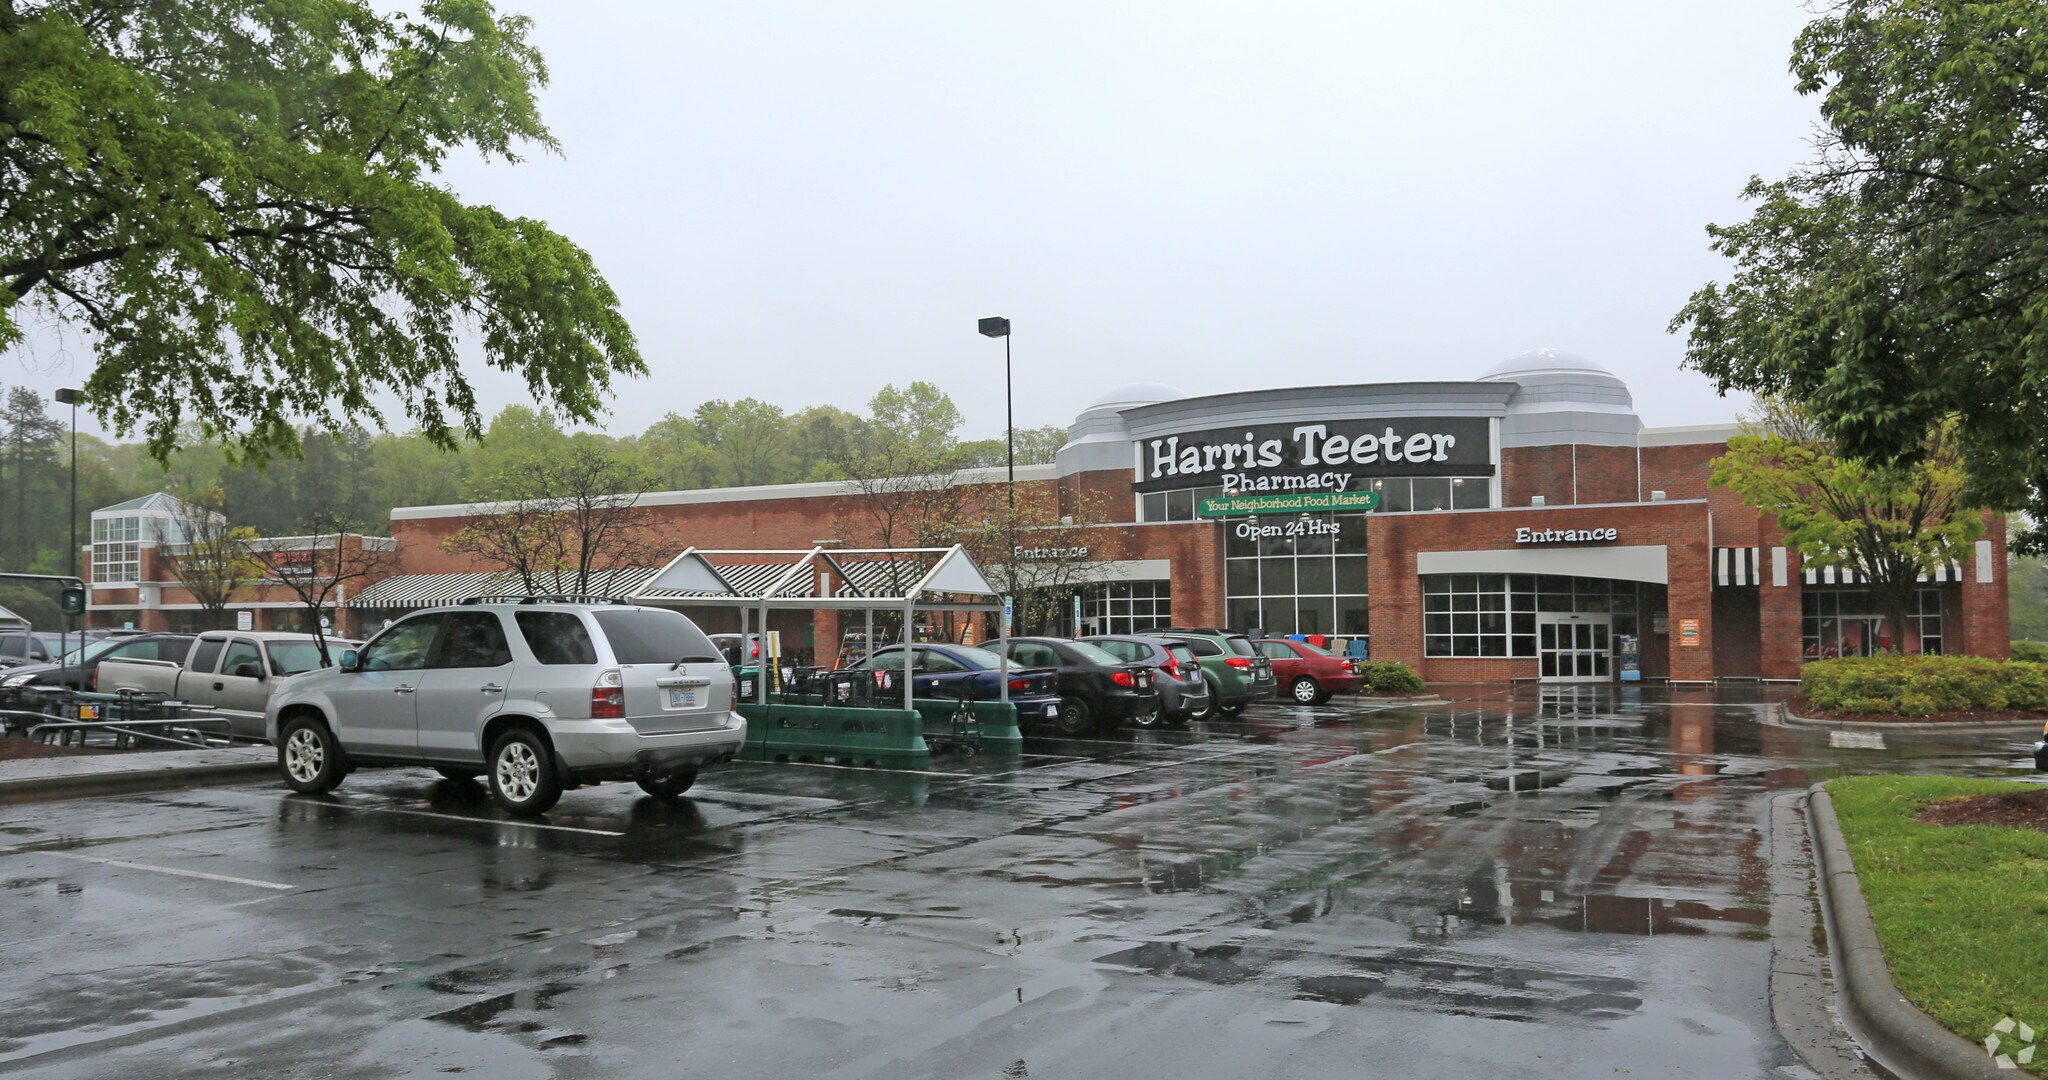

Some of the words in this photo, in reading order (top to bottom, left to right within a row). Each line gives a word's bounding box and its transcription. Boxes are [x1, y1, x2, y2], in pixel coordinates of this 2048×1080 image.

[1151, 432, 1282, 478] Harris
[1293, 424, 1455, 465] Teeter
[1222, 472, 1351, 493] Pharmacy
[1206, 499, 1230, 512] Your
[1231, 496, 1302, 513] Neighborhood
[1304, 495, 1329, 507] Food
[1331, 494, 1371, 506] Market
[1236, 522, 1282, 541] Open
[1286, 521, 1305, 536] 24
[1308, 519, 1340, 535] Hrs
[1515, 527, 1617, 543] Entrance
[1014, 546, 1088, 559] Entrance
